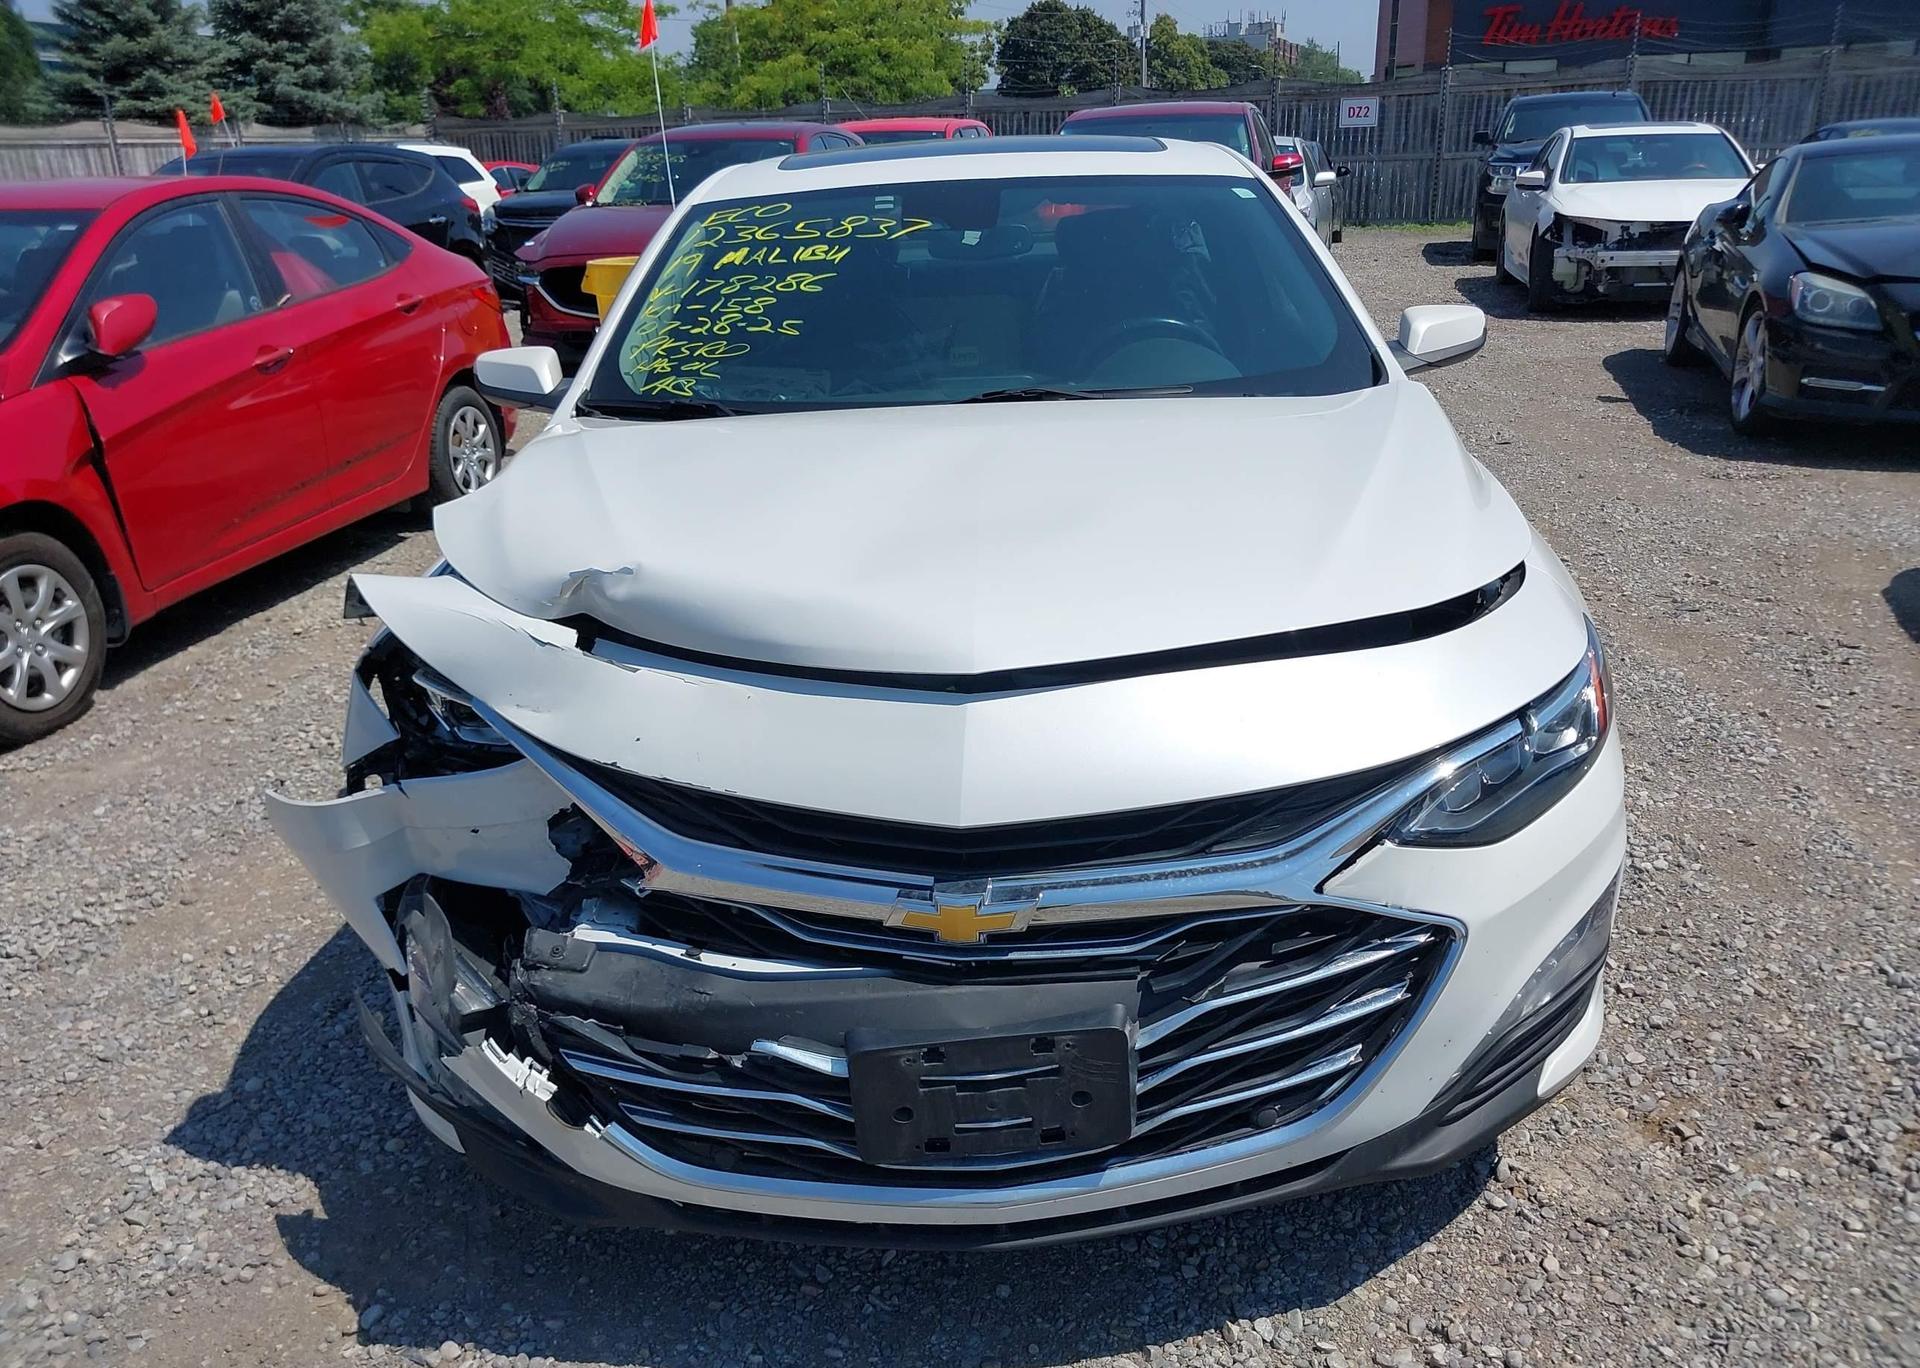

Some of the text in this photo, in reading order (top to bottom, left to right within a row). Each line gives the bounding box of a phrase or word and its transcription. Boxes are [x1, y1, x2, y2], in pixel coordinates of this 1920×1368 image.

[1483, 0, 1679, 46] Tim Hortons
[1348, 106, 1370, 119] DZ2
[662, 244, 852, 279] 19 MALIBU
